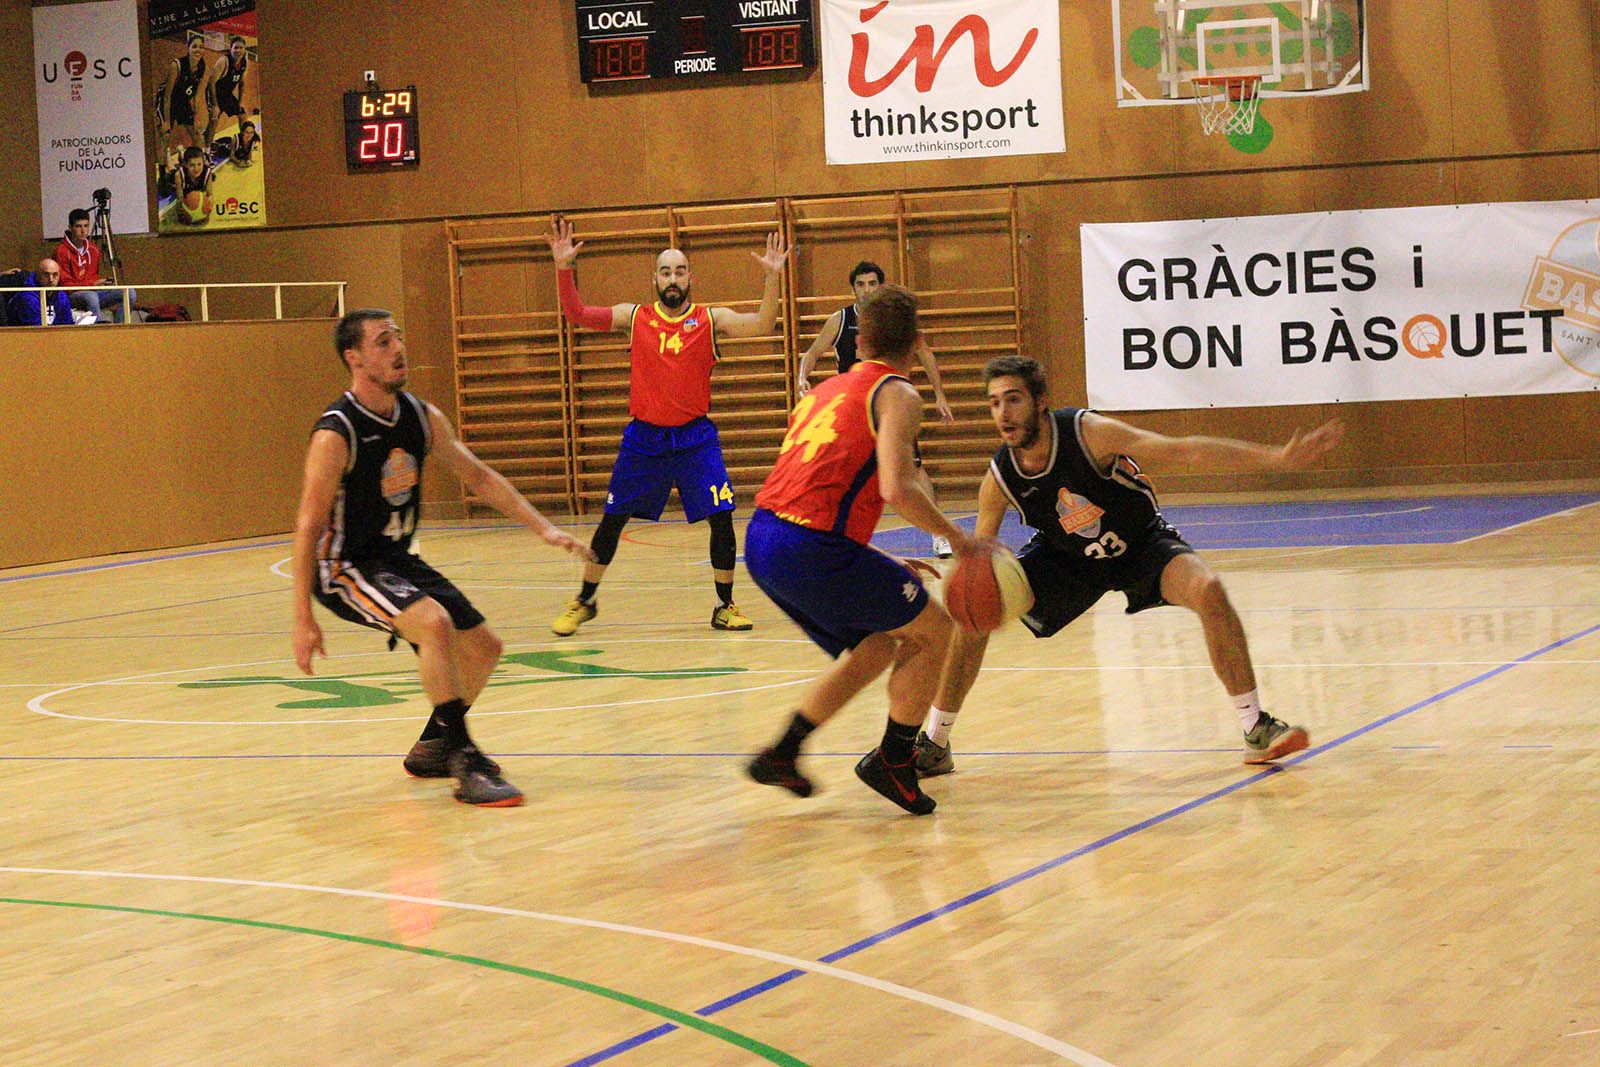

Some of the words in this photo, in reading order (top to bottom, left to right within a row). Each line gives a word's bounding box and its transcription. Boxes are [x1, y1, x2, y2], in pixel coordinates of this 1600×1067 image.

[588, 11, 648, 30] LOCAL
[739, 0, 798, 18] VISITANT
[848, 0, 1039, 98] in
[43, 57, 132, 83] UESC
[675, 57, 716, 74] PERIODE
[361, 92, 410, 117] 6:29
[850, 98, 1039, 139] thinksport
[51, 135, 132, 149] PATROCINADORS
[78, 148, 90, 157] DE
[93, 147, 105, 156] LA
[360, 123, 402, 159] 20
[882, 138, 1011, 155] www.thinkinsport.com
[59, 154, 126, 172] FUNDACIÓ
[215, 200, 259, 216] UESC
[1117, 244, 1377, 302] GRÀCIES
[1413, 245, 1424, 288] i
[659, 332, 684, 355] 14
[1123, 325, 1242, 370] BON
[1281, 307, 1564, 364] BÀSQUET
[1561, 329, 1593, 344] SANT
[779, 392, 847, 463] 24
[710, 481, 734, 506] 14
